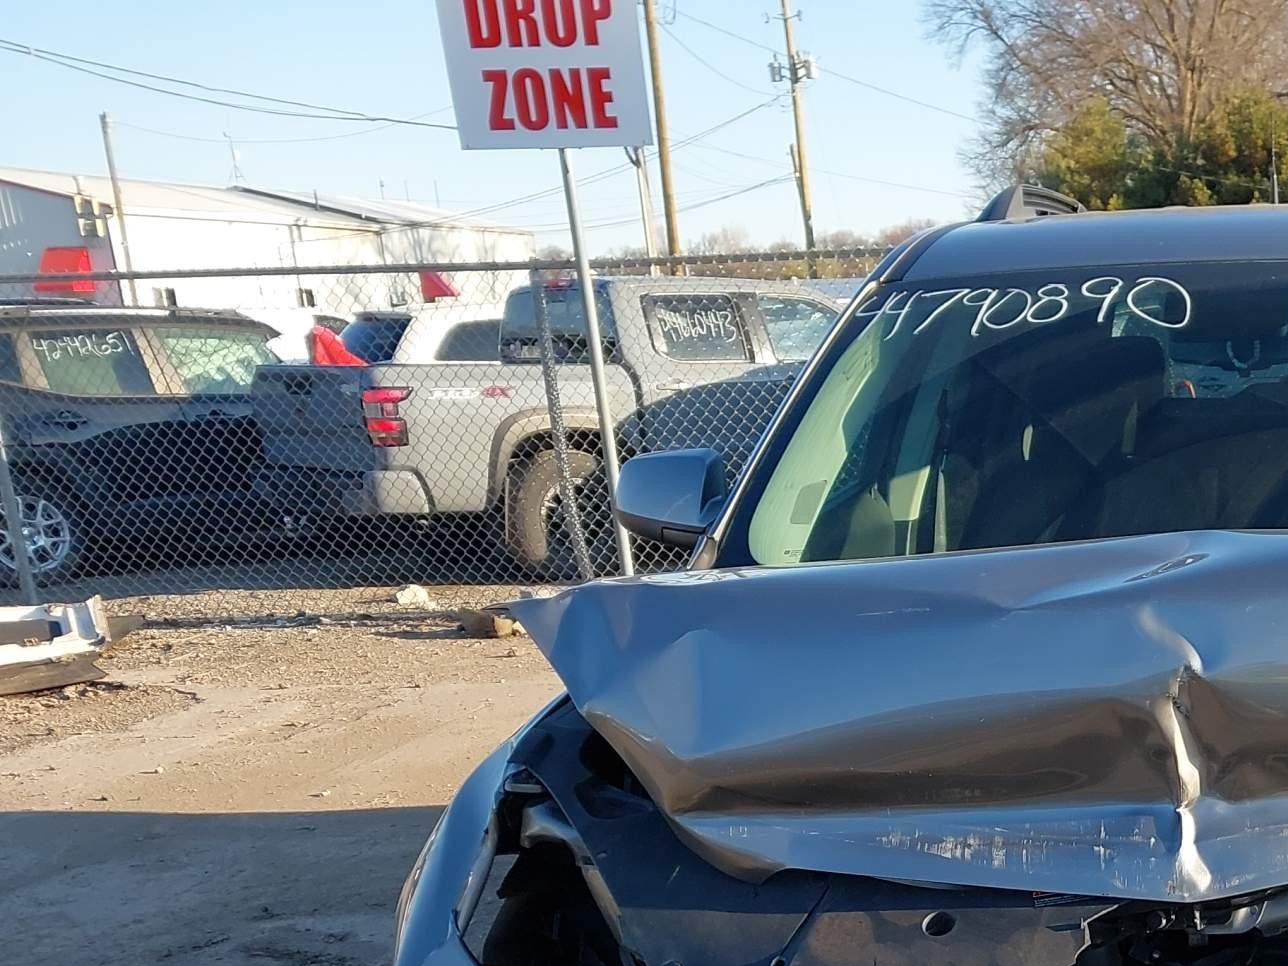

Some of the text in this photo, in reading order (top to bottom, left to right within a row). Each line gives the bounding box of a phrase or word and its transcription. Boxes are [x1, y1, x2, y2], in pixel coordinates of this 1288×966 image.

[463, 0, 613, 48] DROP
[481, 66, 619, 131] ZONE
[855, 276, 1191, 341] 44790890
[32, 331, 135, 361] 42442651
